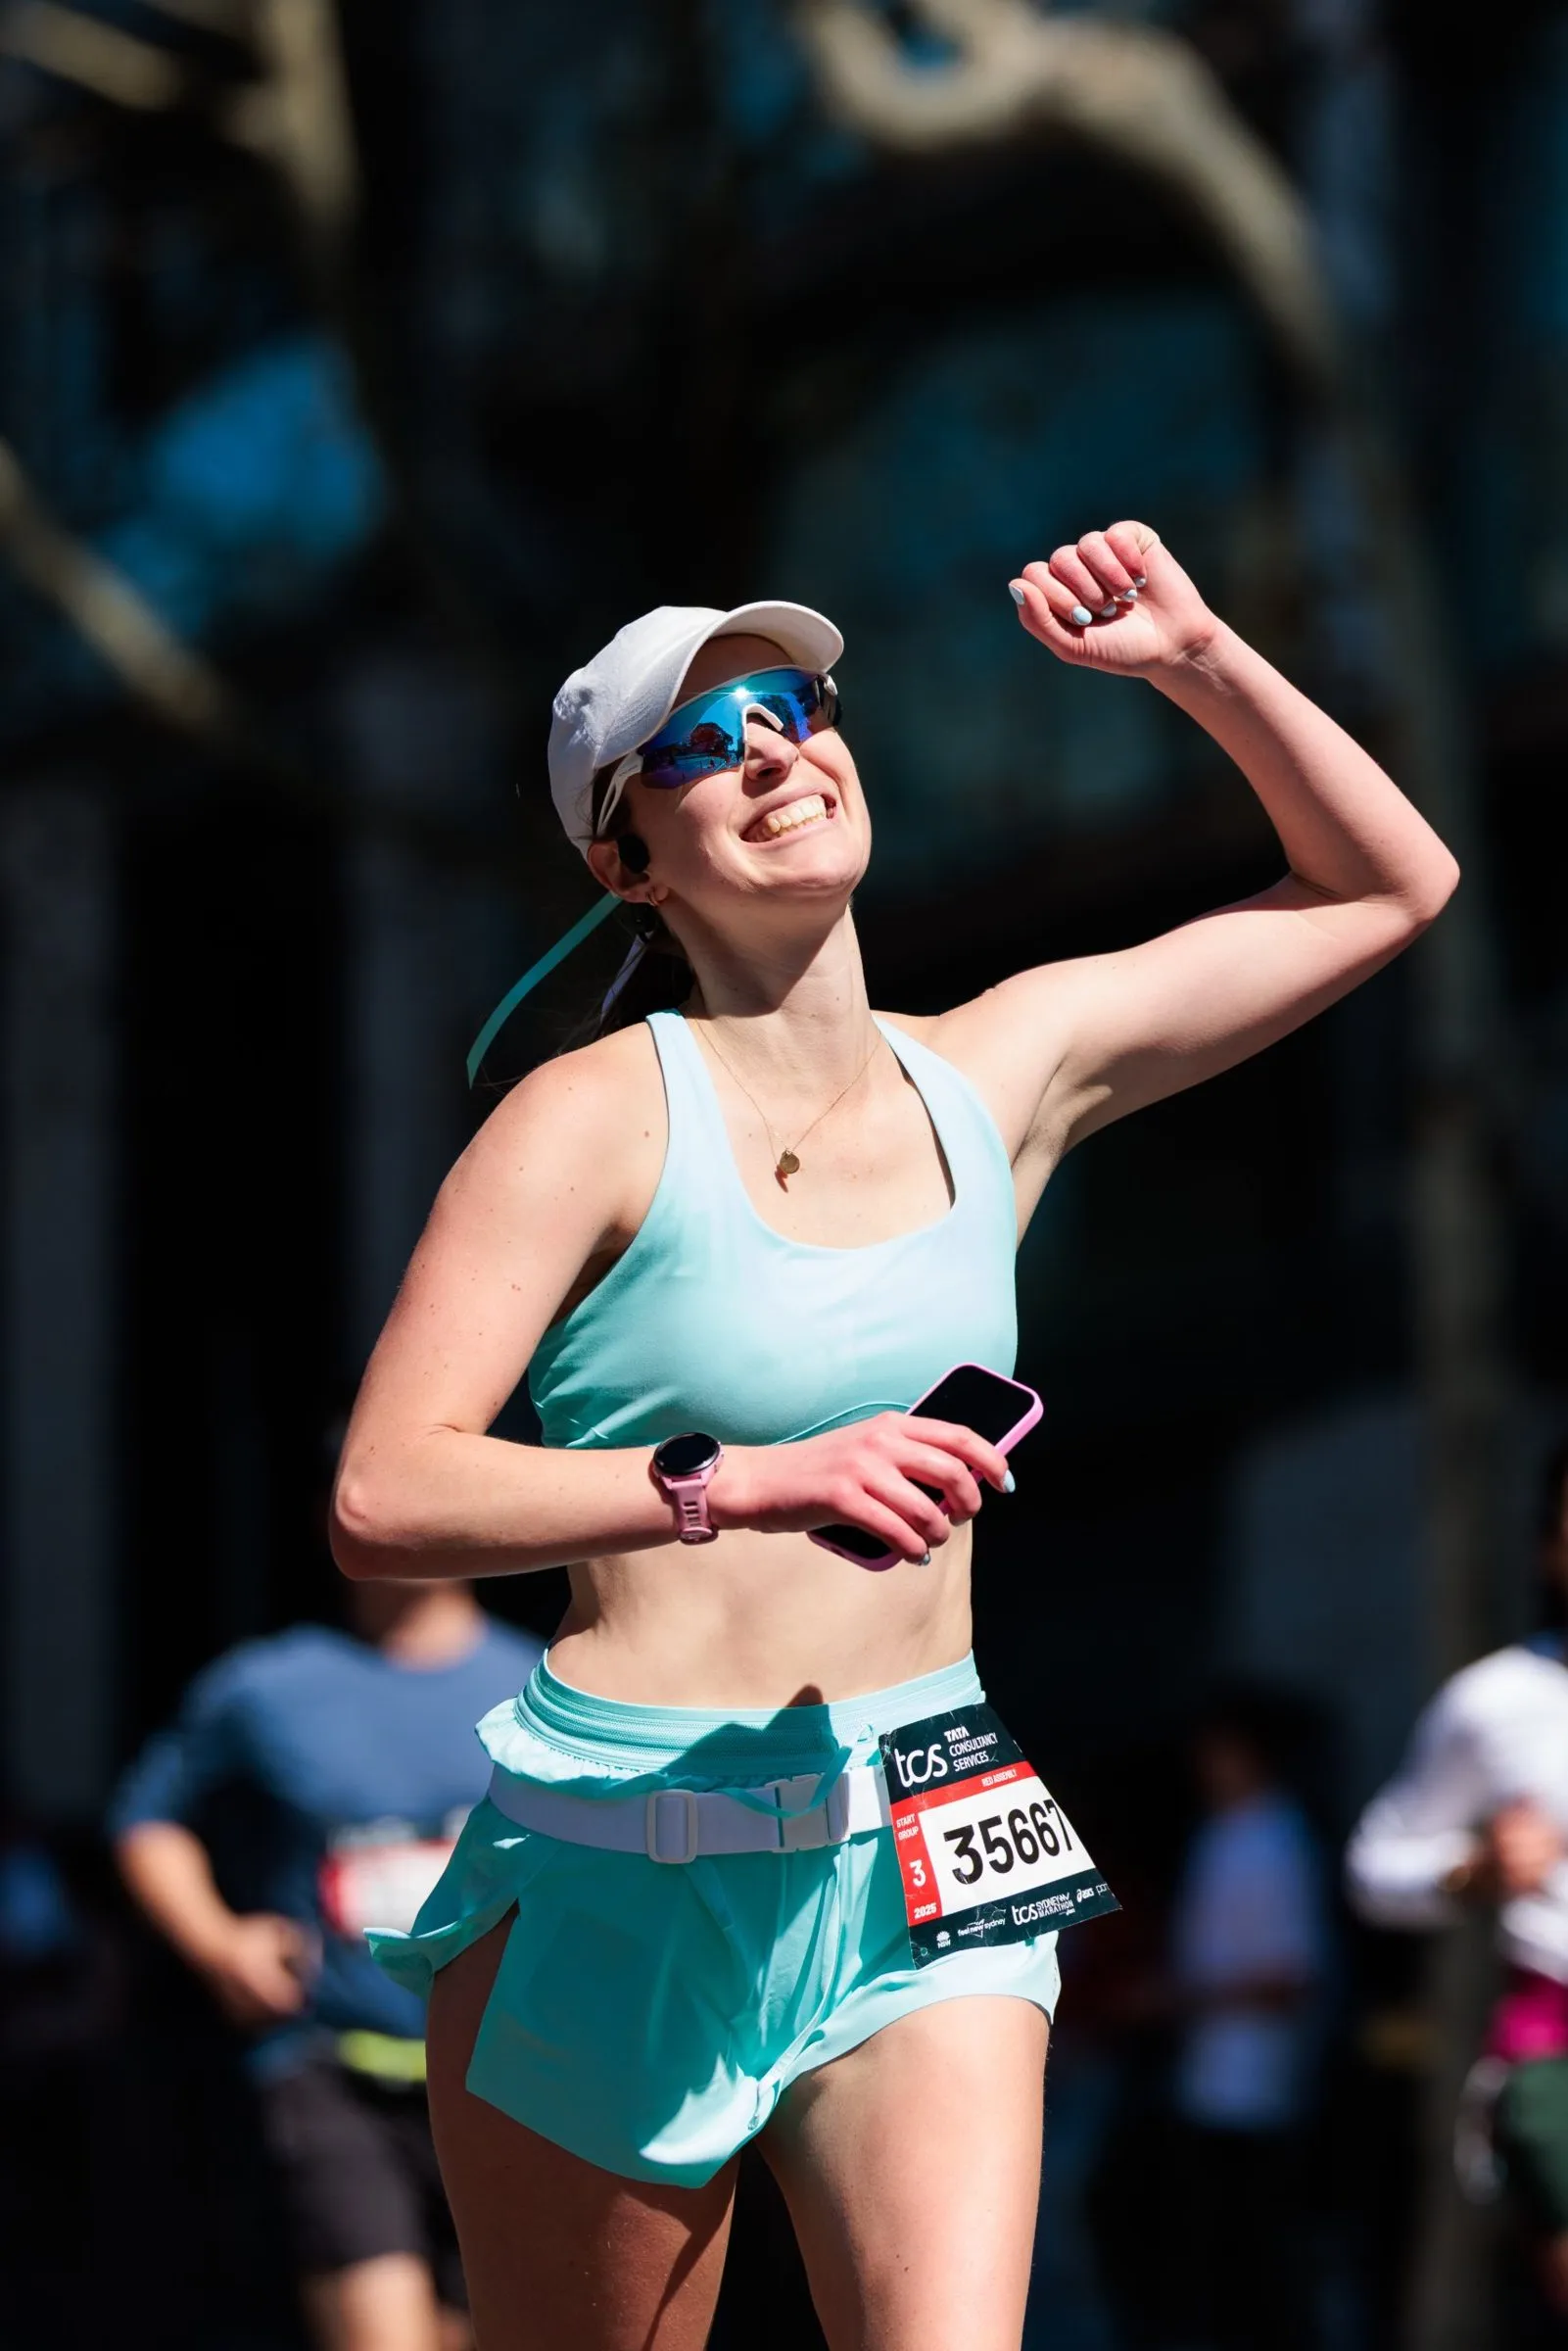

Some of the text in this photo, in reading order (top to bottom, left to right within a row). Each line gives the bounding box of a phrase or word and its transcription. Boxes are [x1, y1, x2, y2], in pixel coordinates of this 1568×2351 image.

[944, 1726, 970, 1742] TATA
[949, 1732, 997, 1756] CONSULTANCY
[894, 1744, 948, 1788] tcs
[953, 1751, 989, 1772] SERVICES
[896, 1813, 916, 1828] START
[898, 1826, 920, 1841] GROUP
[943, 1799, 1072, 1886] 35667
[909, 1859, 927, 1887] 3
[914, 1902, 937, 1919] 2025
[1036, 1895, 1060, 1910] SYDNEY
[1038, 1900, 1073, 1917] MARATHON
[1011, 1903, 1039, 1926] tcs
[958, 1918, 1005, 1936] feel new sydney
[937, 1939, 951, 1949] NSW
